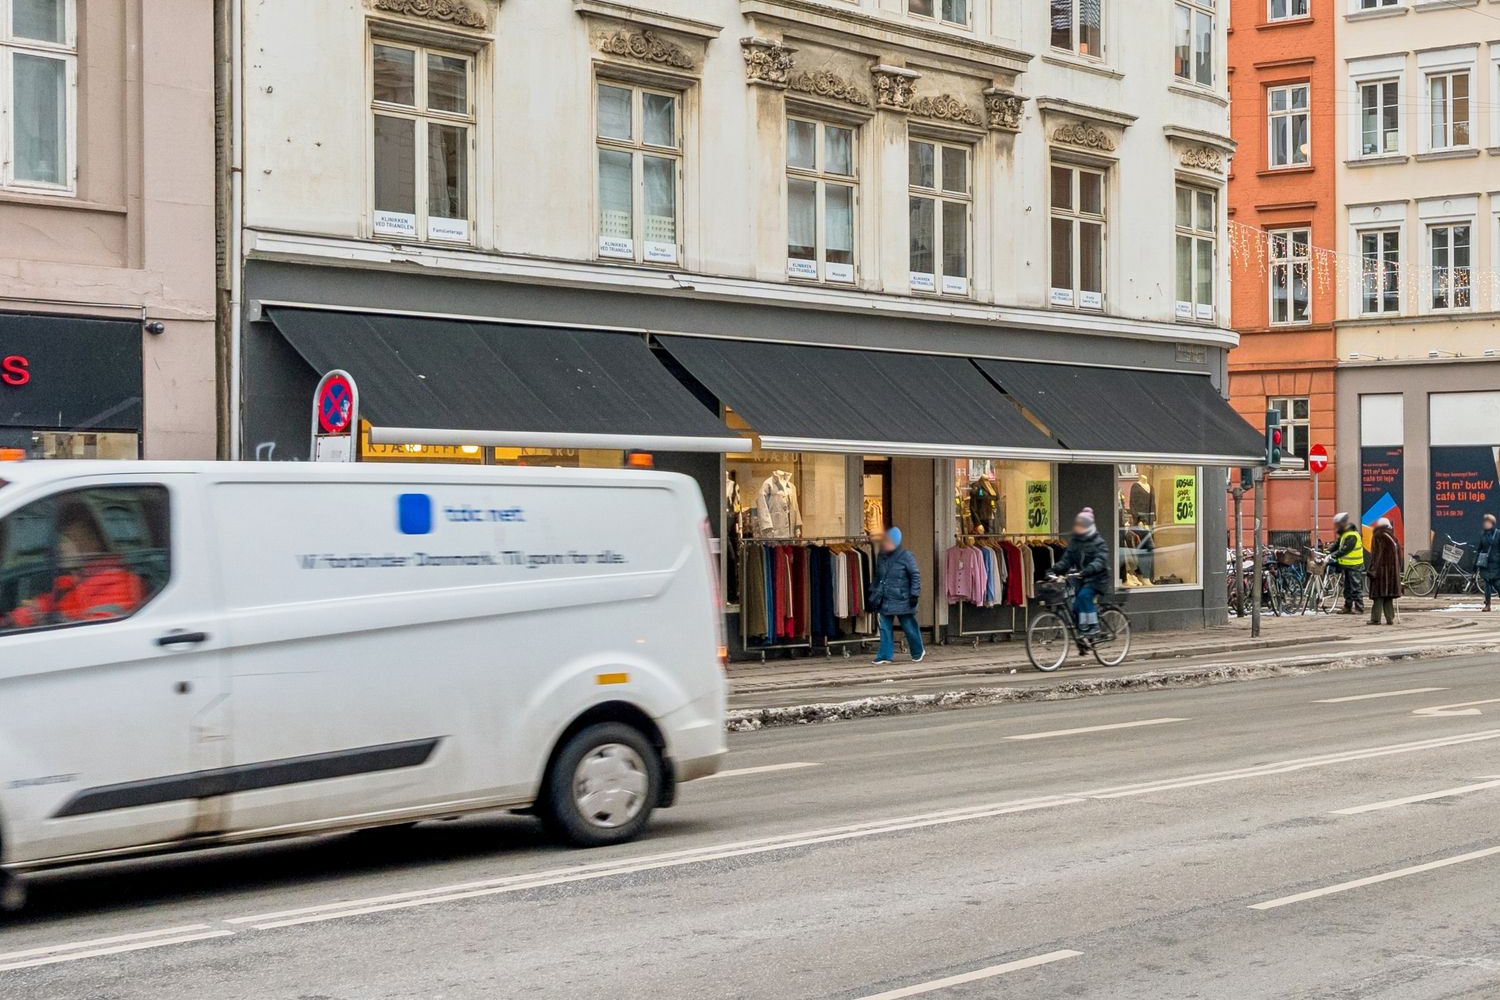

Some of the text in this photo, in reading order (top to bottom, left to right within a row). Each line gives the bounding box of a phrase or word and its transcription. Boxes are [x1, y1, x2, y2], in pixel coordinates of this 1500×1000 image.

[375, 220, 414, 230] VED TRIANGLEN
[380, 216, 409, 224] KLINIKKEN
[1435, 480, 1494, 490] 311 m² butik/
[1435, 491, 1486, 503] café til leje
[1176, 502, 1194, 521] 50%
[1028, 508, 1048, 528] 50%
